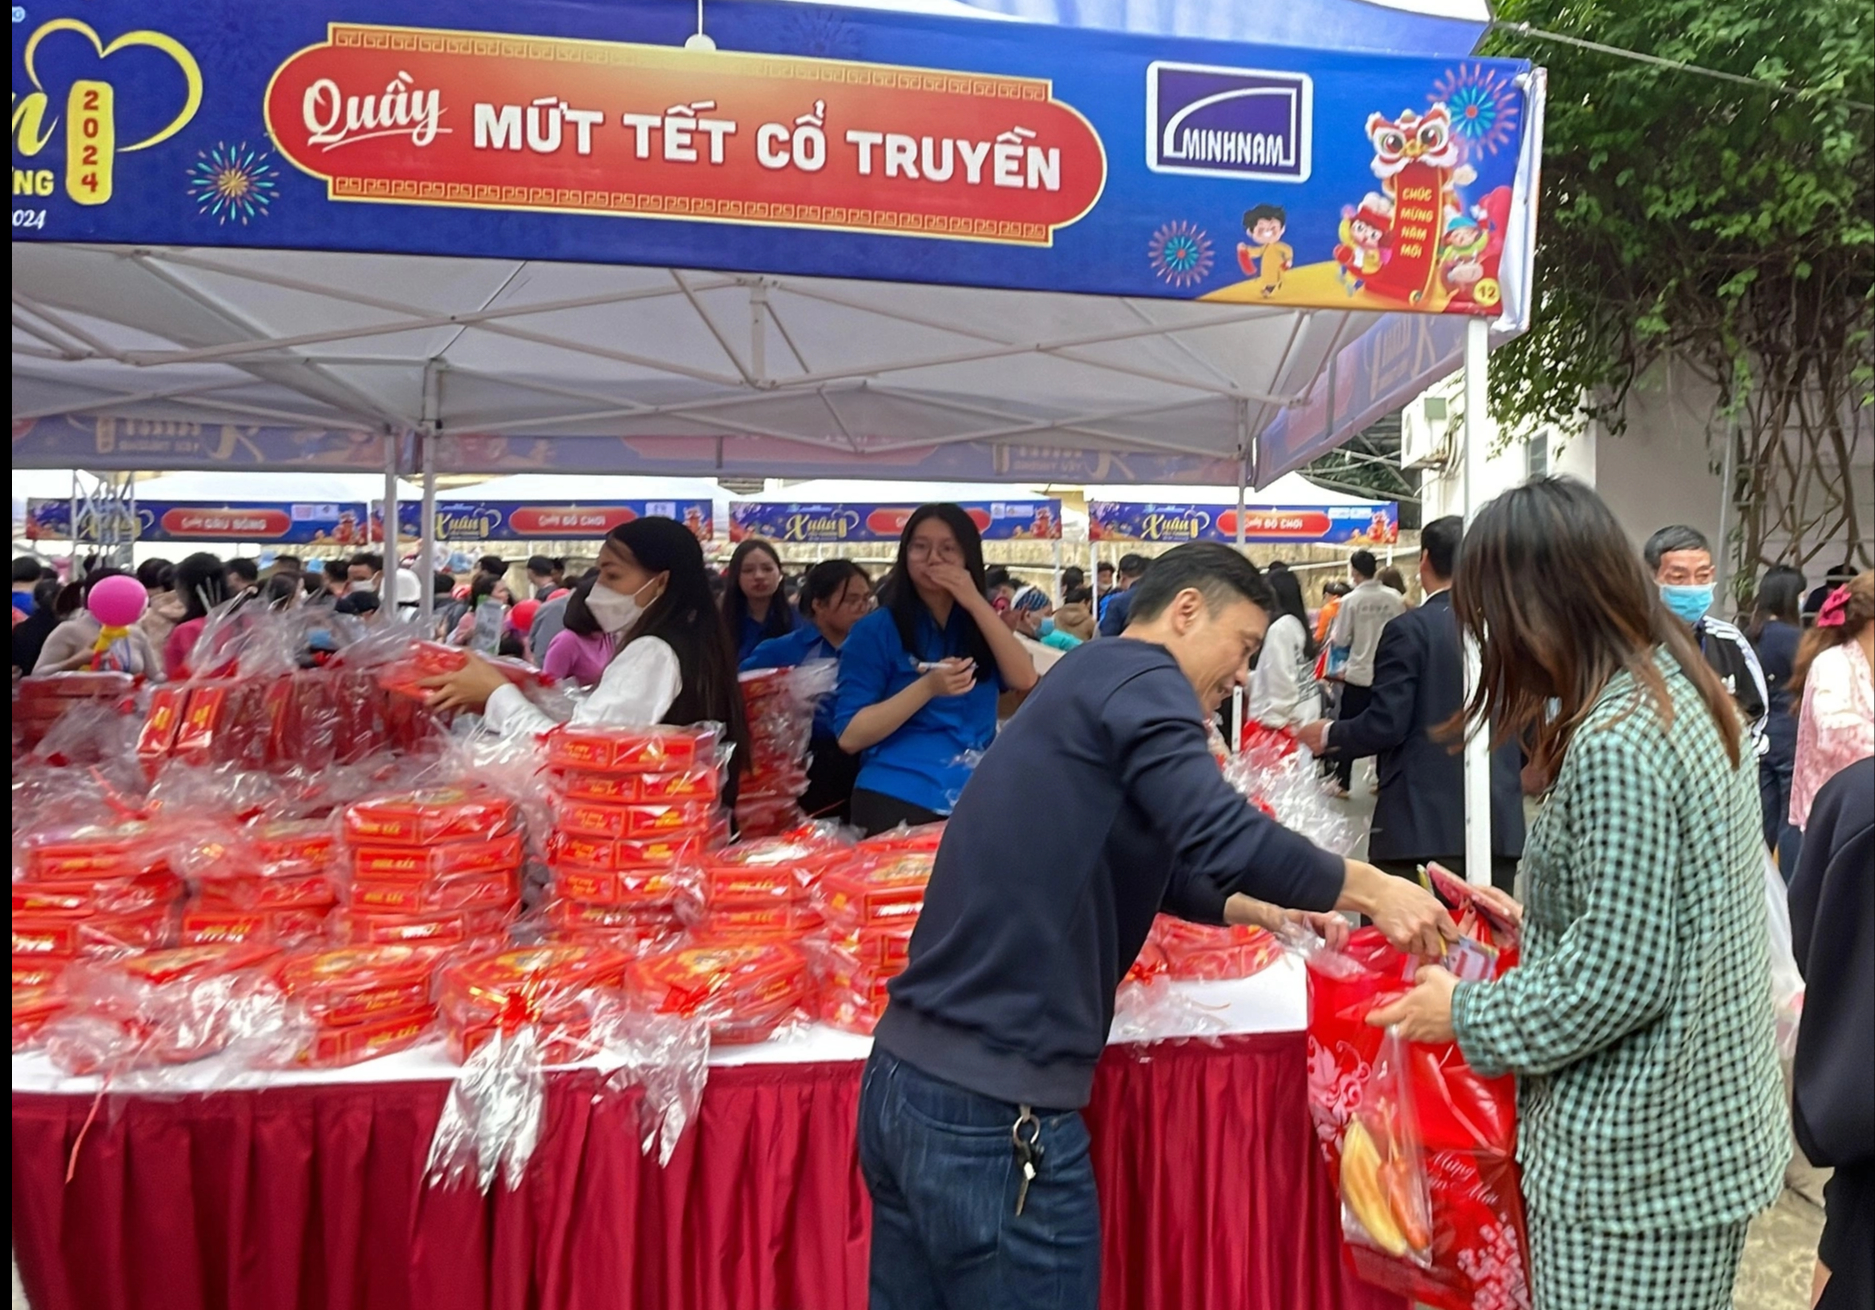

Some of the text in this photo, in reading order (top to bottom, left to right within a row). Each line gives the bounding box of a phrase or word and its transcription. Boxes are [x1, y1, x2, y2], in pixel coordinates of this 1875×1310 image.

[81, 90, 100, 193] 2024
[303, 70, 1061, 191] Quầy MỨT TẾT CỔ TRUYỀN
[1182, 127, 1284, 166] MINHNAM
[1402, 186, 1433, 201] CHÚC
[12, 209, 47, 230] 024
[1479, 285, 1497, 298] 12
